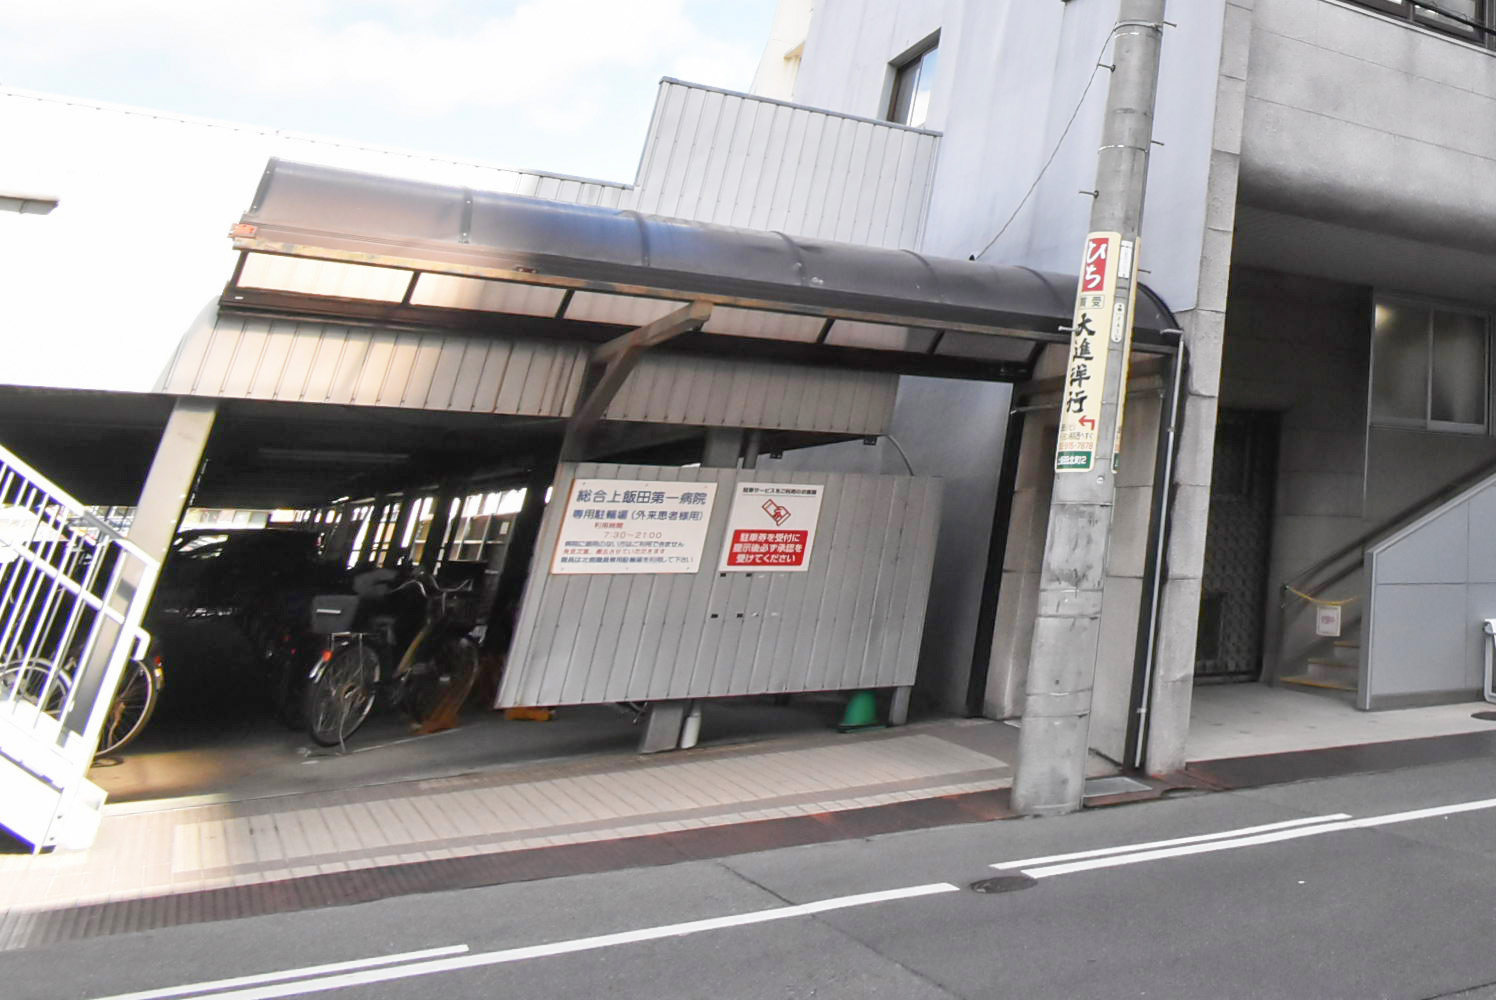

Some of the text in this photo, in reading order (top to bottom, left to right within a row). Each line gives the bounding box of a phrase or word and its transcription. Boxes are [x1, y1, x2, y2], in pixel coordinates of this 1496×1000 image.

[1085, 240, 1108, 289] ひち
[1065, 312, 1097, 414] 大進洋行
[576, 489, 708, 505] 総合上飯田第一病院
[740, 533, 801, 543] 駐車券を受付に
[736, 554, 796, 564] 受けてください
